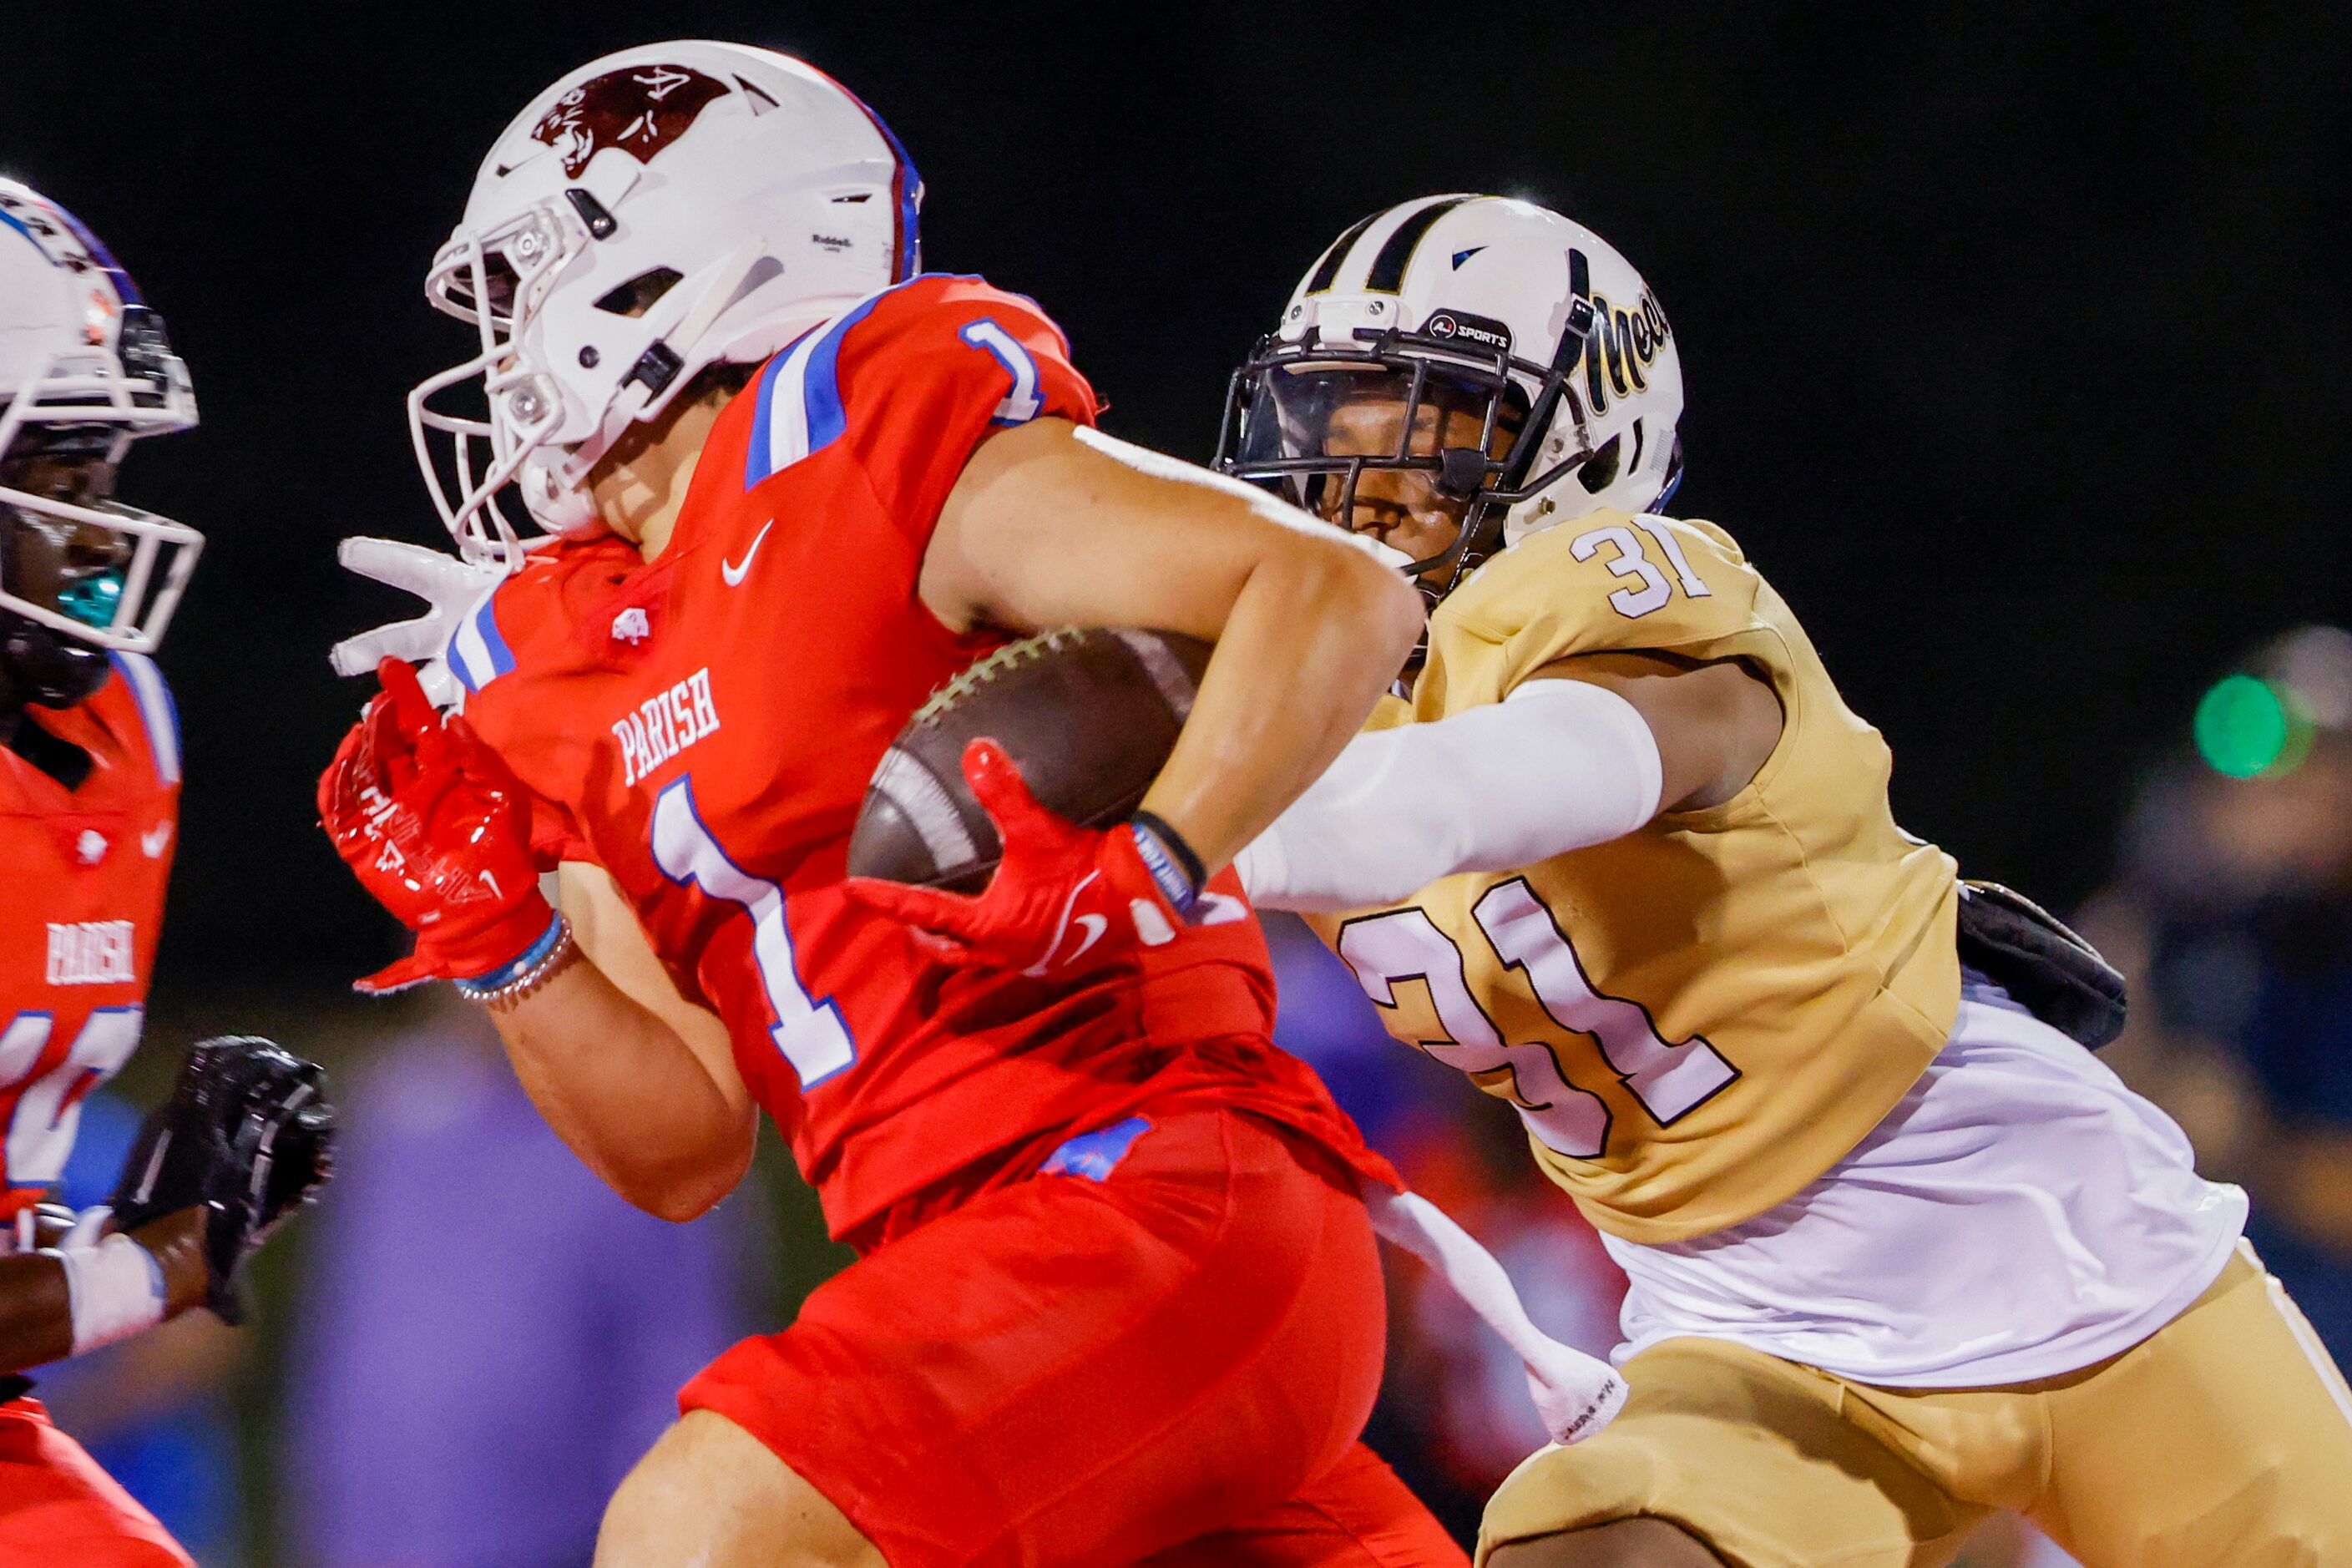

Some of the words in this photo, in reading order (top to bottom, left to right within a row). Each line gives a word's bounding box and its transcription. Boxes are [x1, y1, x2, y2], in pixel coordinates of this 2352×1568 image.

[959, 316, 1047, 427] 1
[1457, 325, 1508, 348] SPORTS
[1569, 517, 1712, 620] 31
[610, 666, 721, 787] PARISH
[651, 771, 858, 1094] 1
[1337, 874, 1743, 1159] 31
